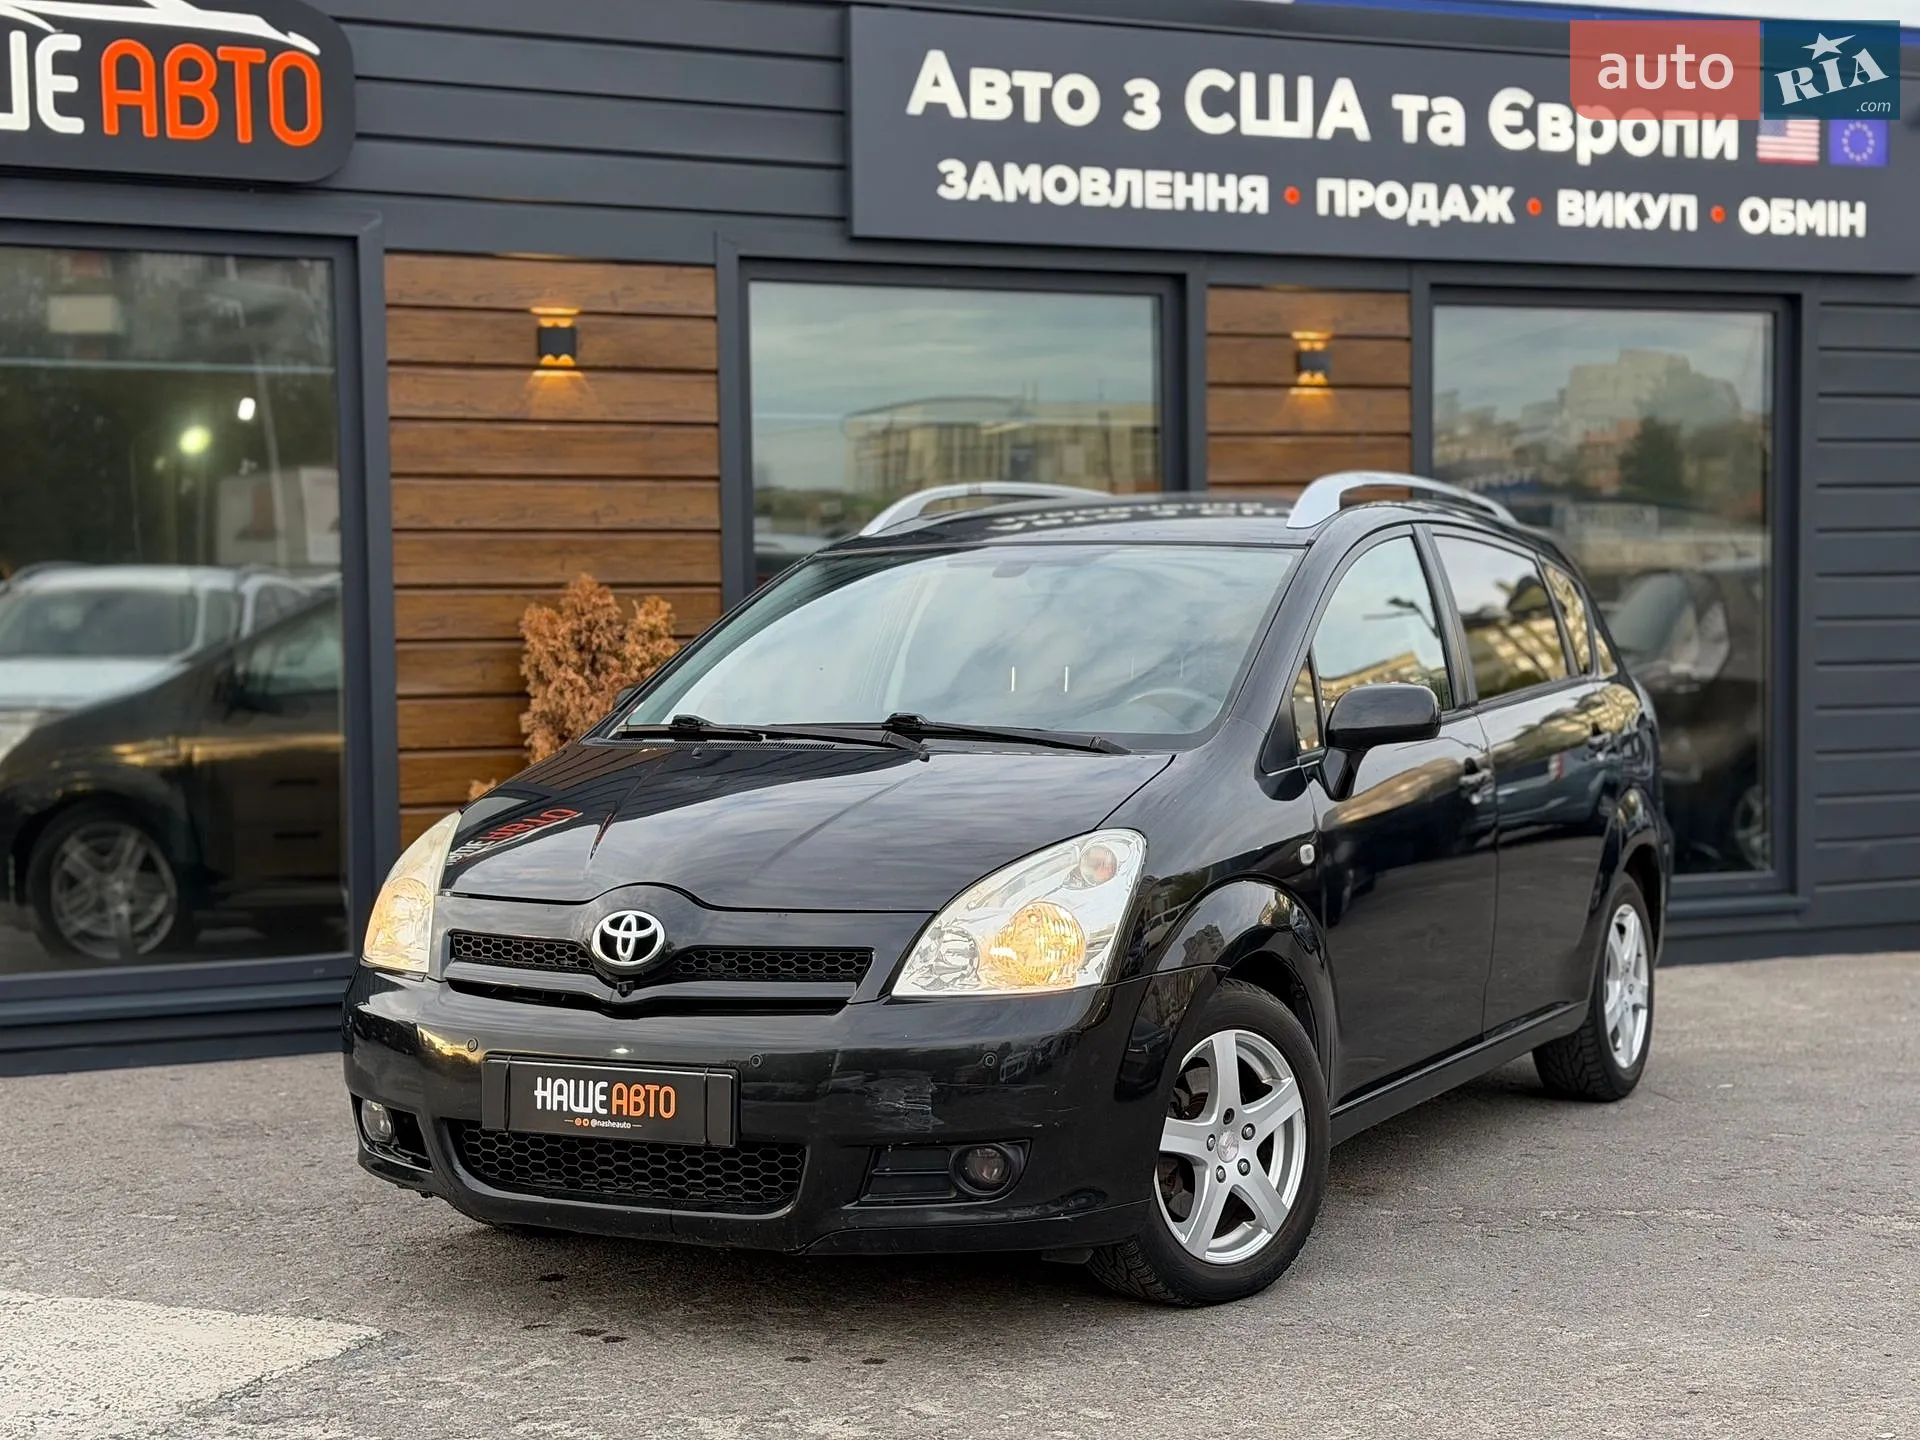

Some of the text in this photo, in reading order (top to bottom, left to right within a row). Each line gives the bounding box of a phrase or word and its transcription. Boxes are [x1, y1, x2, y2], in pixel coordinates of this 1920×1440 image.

[101, 38, 322, 146] АВТО
[906, 49, 1101, 127] Авто
[1184, 68, 1371, 141] США
[1391, 93, 1467, 147] та
[1487, 87, 1739, 166] Європи
[936, 158, 1868, 239] ЗАМОВЛЕННЯ ПРОДАЖ ВИКУП ОБМІН
